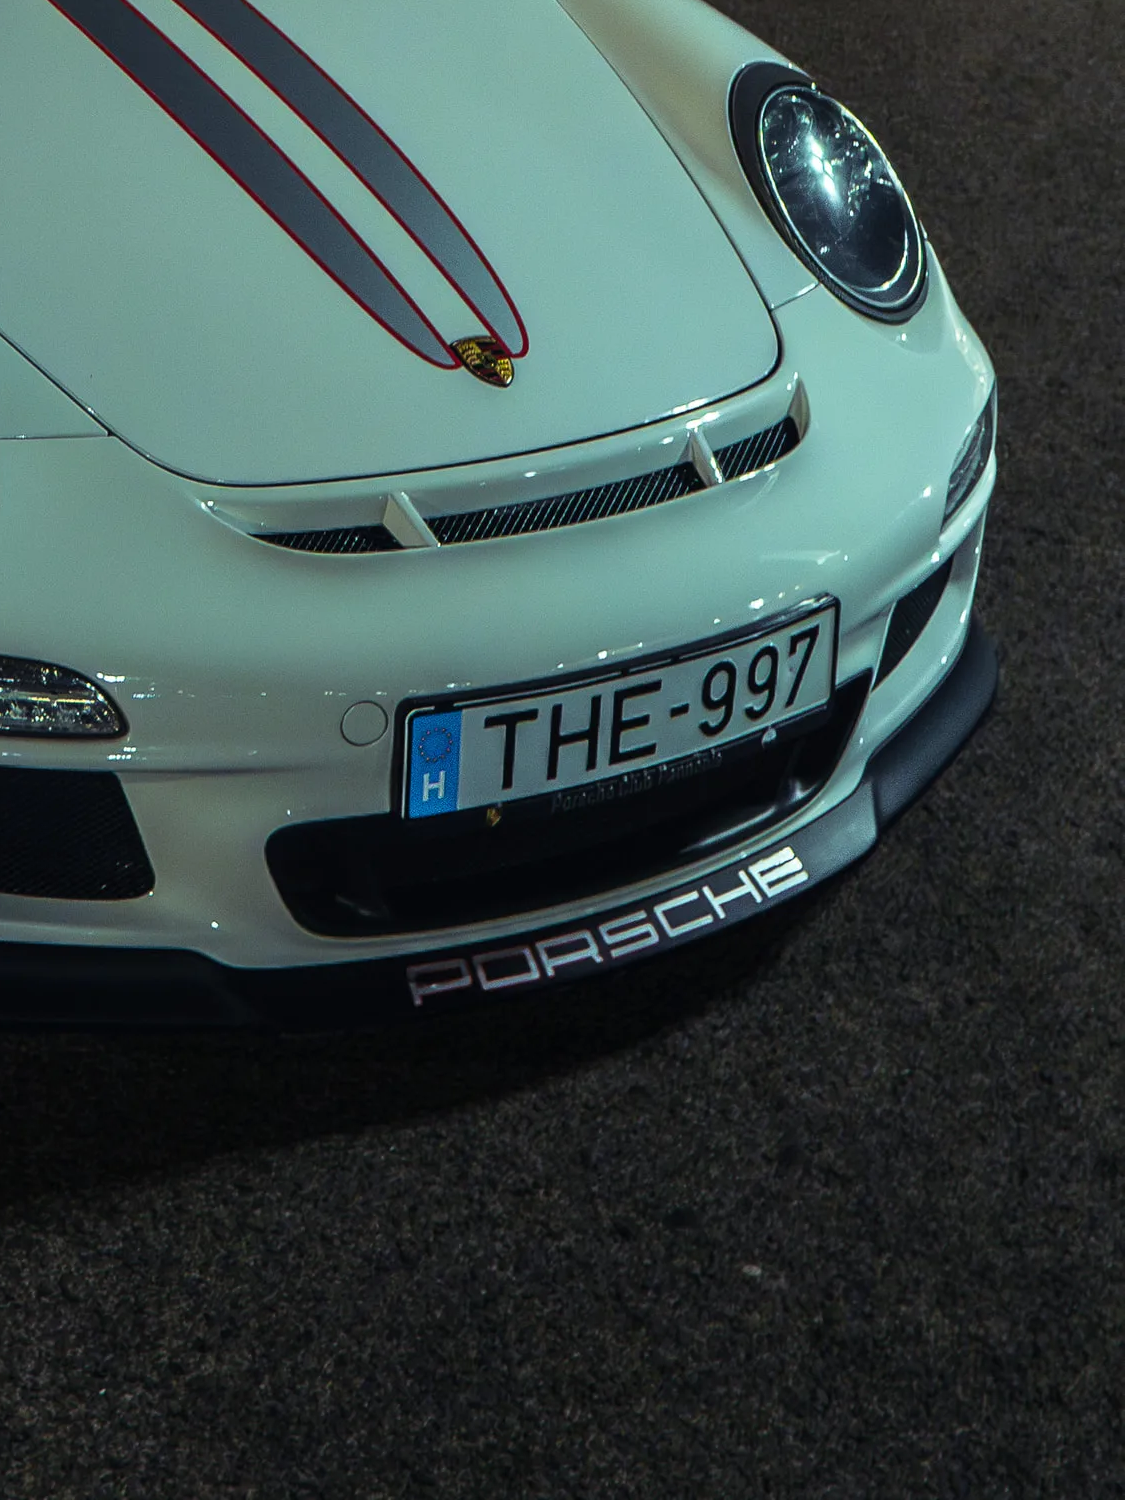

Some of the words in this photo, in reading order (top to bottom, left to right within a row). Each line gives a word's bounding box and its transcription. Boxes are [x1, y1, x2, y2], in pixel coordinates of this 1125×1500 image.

[422, 770, 447, 802] H
[483, 623, 820, 791] THE-997
[406, 845, 810, 1007] PORSCHE
